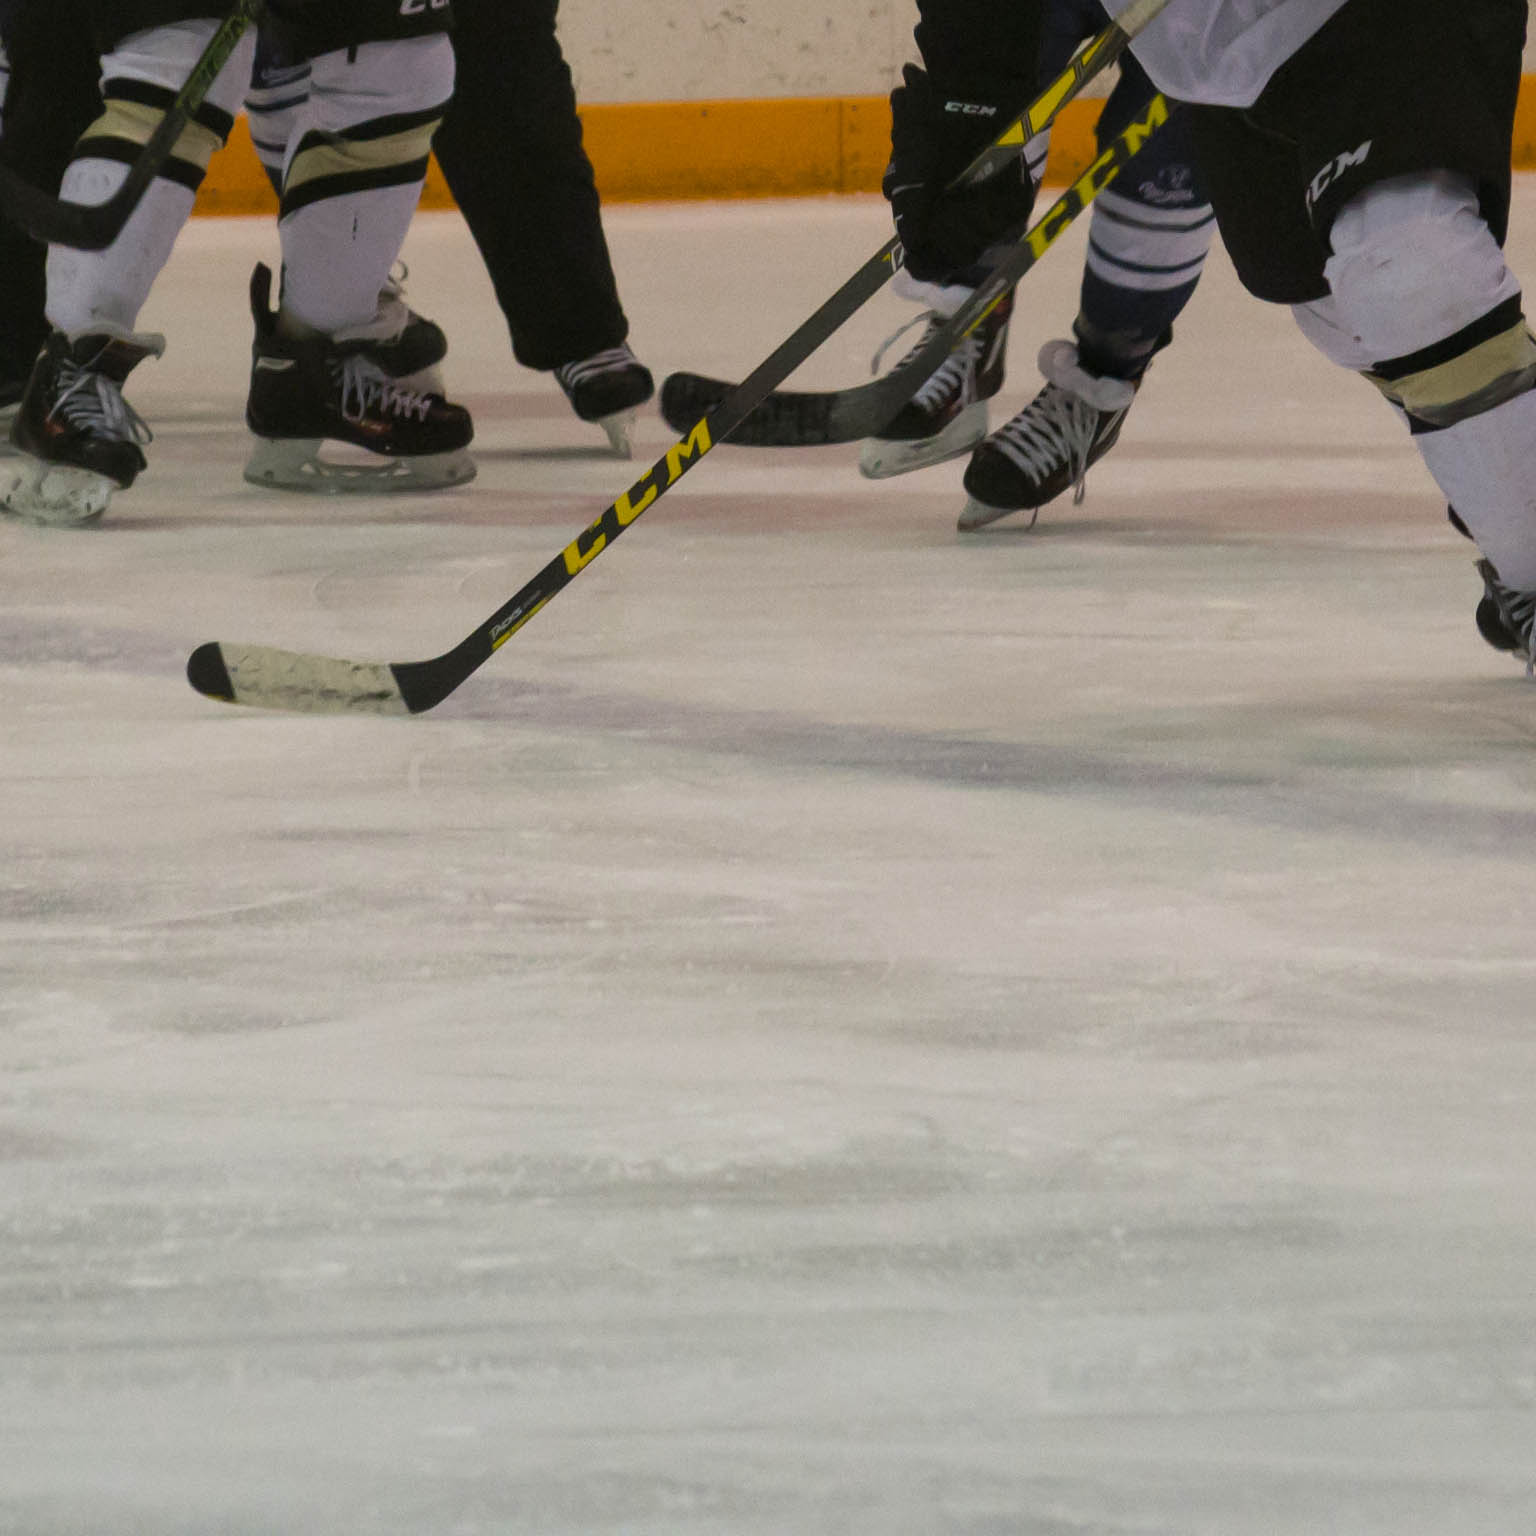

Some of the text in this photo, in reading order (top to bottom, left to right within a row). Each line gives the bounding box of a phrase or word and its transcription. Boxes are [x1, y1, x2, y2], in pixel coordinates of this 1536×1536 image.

[944, 100, 998, 116] CCM
[1026, 92, 1169, 260] CCM
[563, 416, 713, 576] CCM
